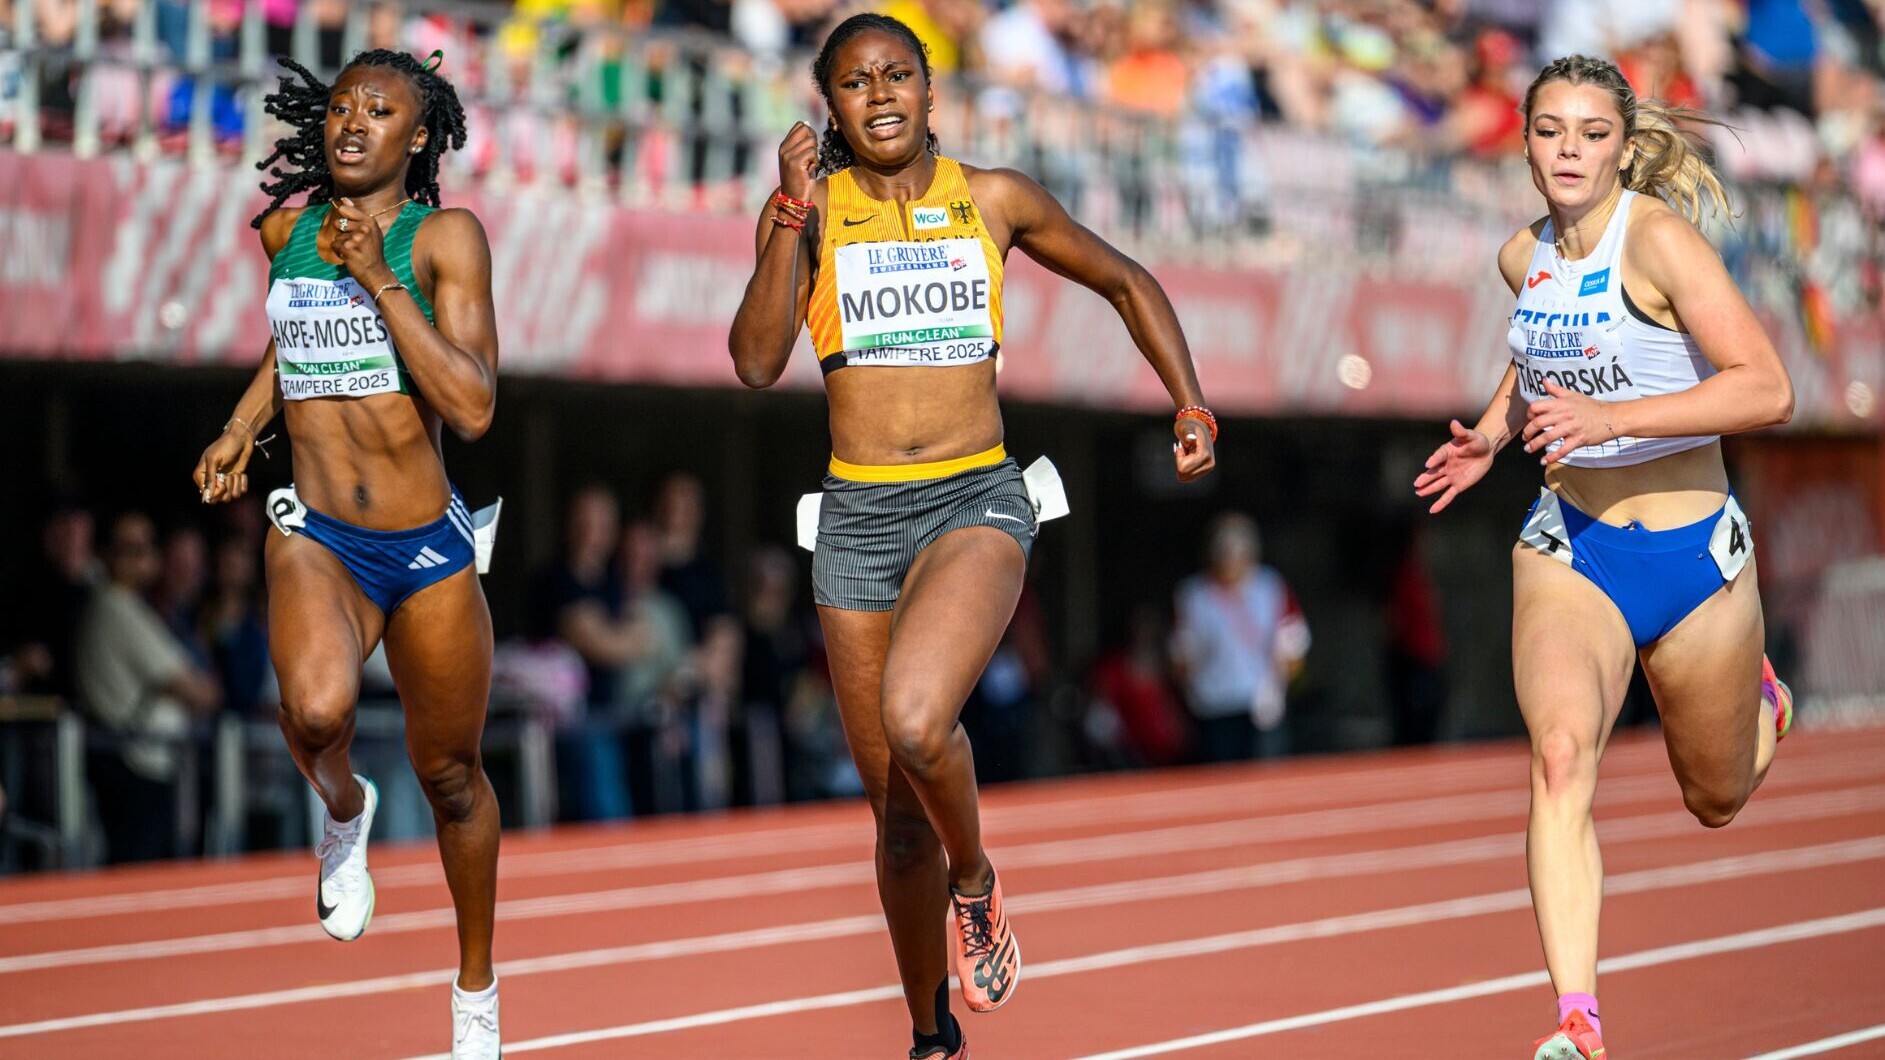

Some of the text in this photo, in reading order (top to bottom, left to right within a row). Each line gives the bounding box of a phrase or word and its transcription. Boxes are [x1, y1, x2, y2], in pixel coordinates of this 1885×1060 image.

[914, 212, 946, 225] WGV
[867, 248, 885, 265] LE
[872, 261, 947, 274] SWITZERLAND
[841, 279, 987, 323] MOKOBE
[272, 315, 388, 349] AKPE-MOSES
[875, 335, 880, 346] I
[882, 332, 914, 346] RUN
[1527, 329, 1582, 349] LE GYÈRE
[946, 342, 985, 360] 2025
[1527, 347, 1581, 358] SWITZERLAND
[283, 372, 390, 394] TAMPERE 2025
[1728, 515, 1747, 557] 4
